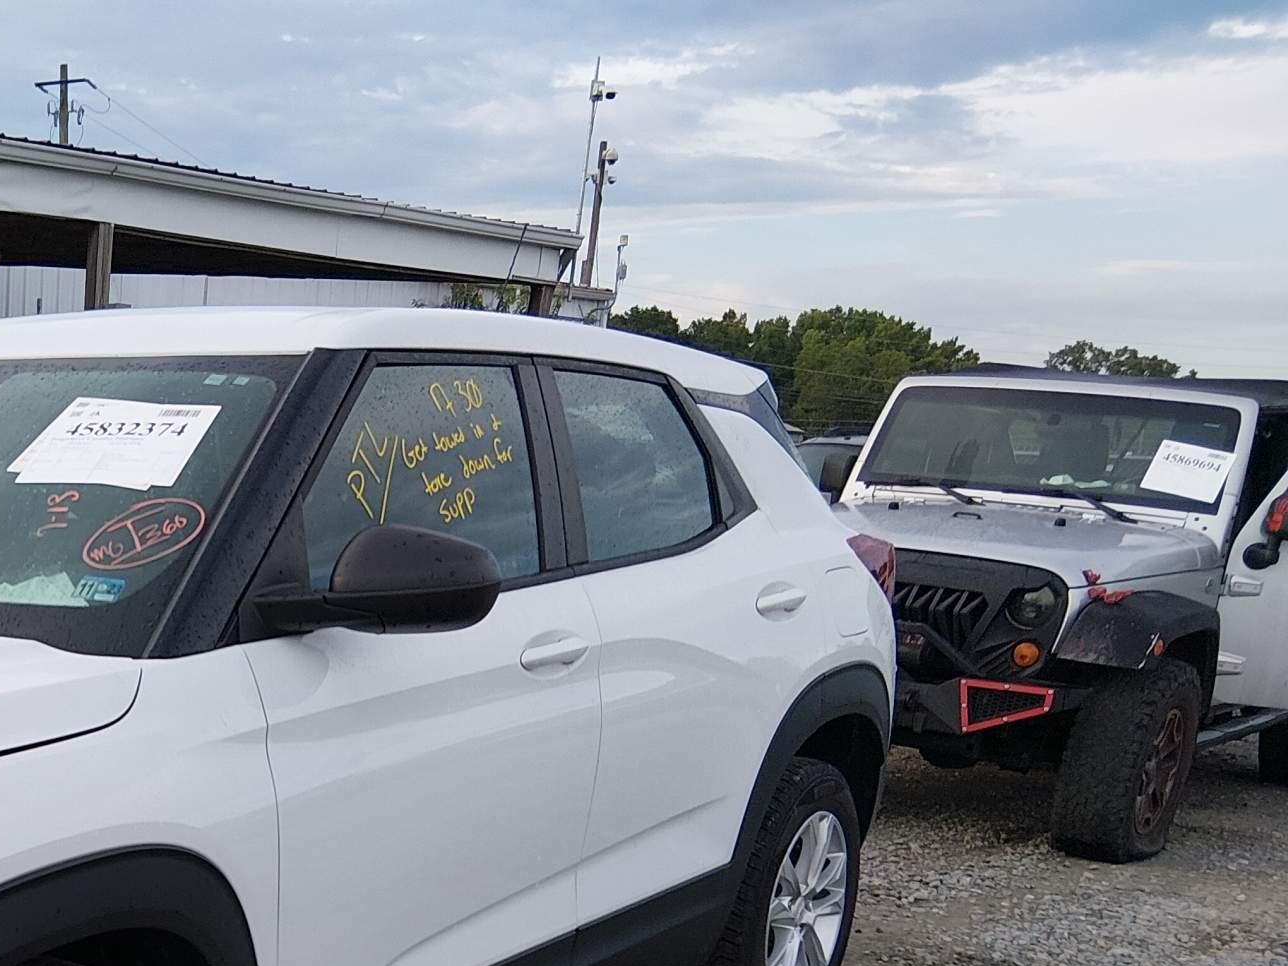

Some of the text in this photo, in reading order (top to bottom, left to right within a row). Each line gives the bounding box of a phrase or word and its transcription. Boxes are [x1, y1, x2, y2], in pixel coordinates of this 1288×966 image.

[65, 421, 189, 437] 45832374
[400, 438, 428, 469] Get
[432, 425, 465, 453] towed
[469, 422, 485, 440] in
[458, 454, 496, 479] down
[493, 437, 513, 465] for
[1162, 452, 1222, 473] 45869694
